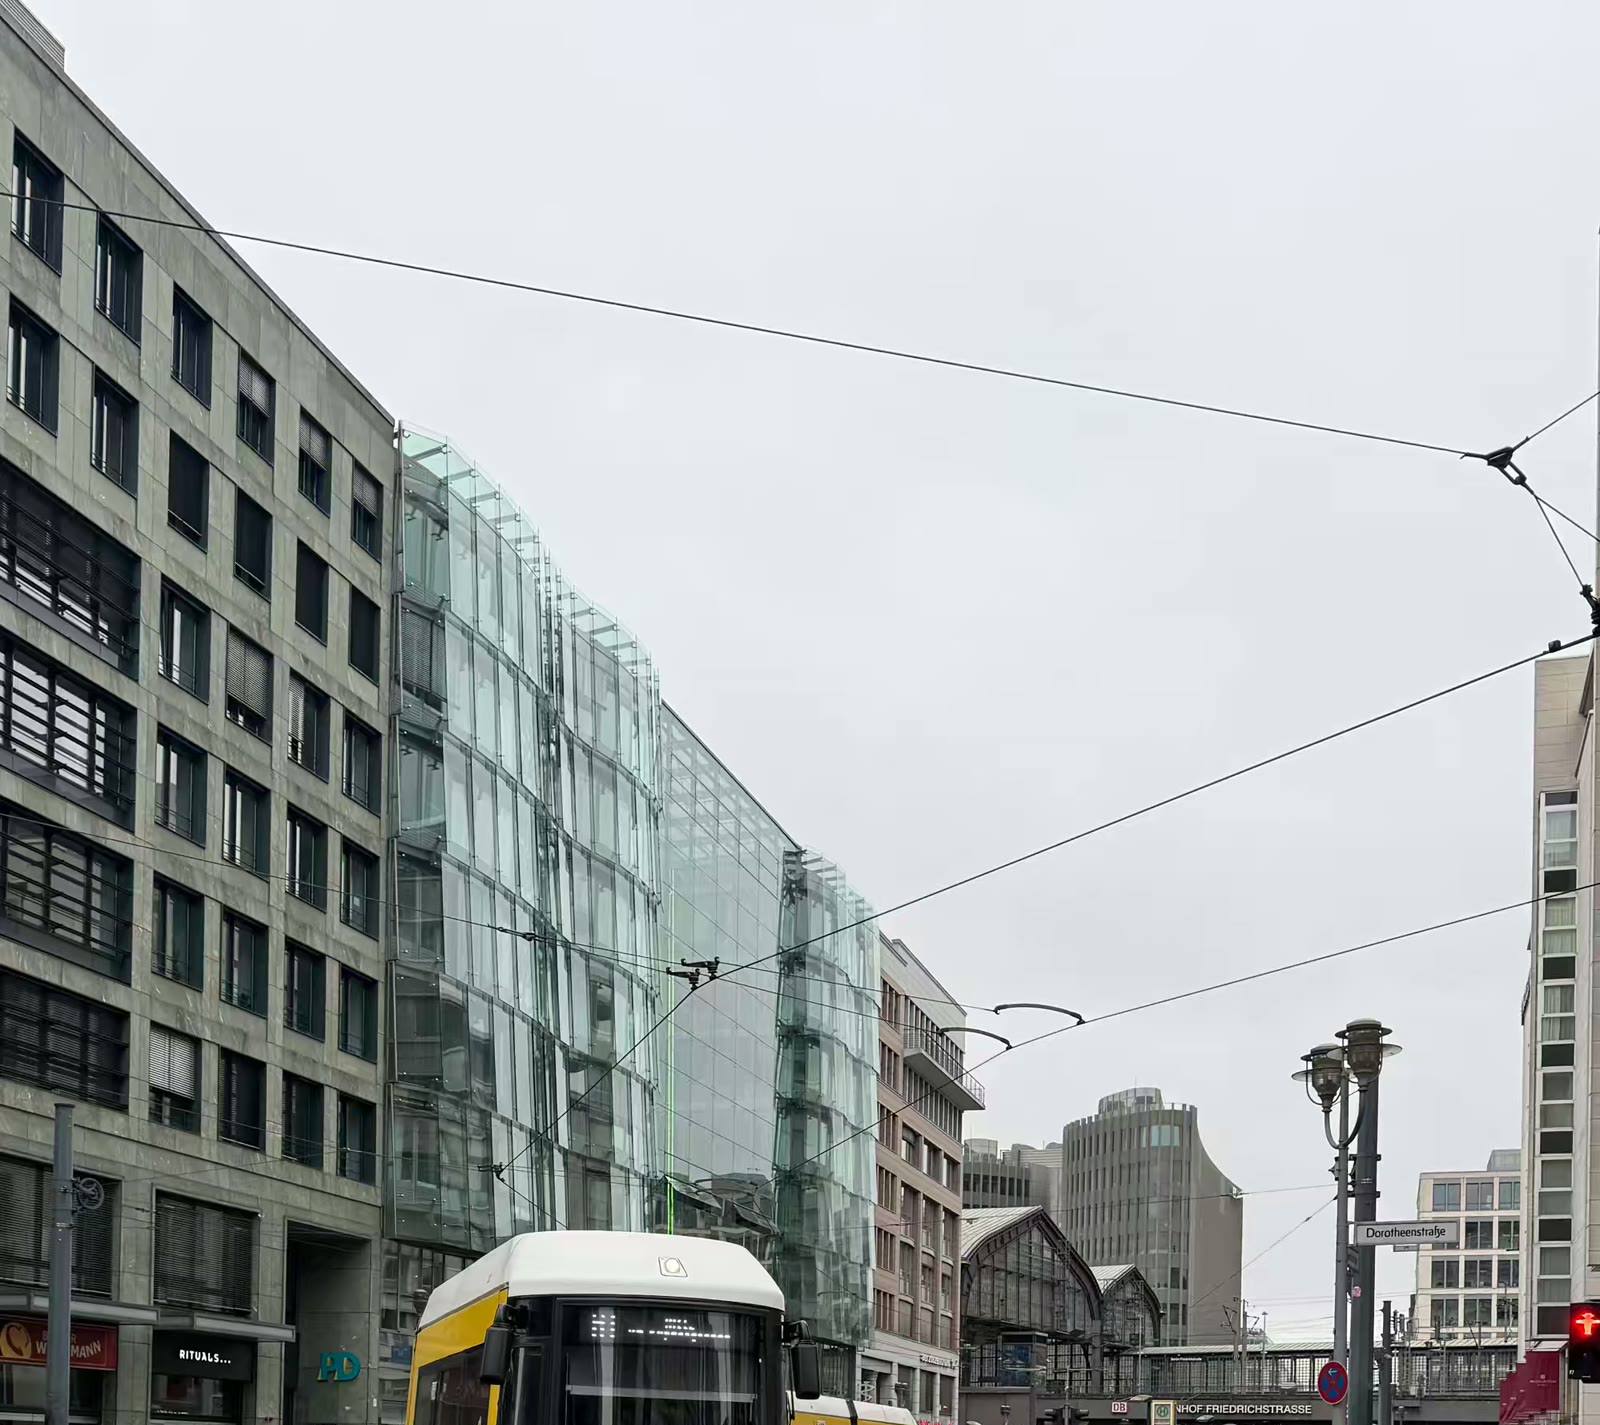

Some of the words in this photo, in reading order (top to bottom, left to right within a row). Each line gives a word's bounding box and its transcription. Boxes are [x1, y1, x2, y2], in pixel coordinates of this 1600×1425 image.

[1366, 1225, 1446, 1239] Dorotheenstraße
[317, 1352, 361, 1381] PD
[1113, 1402, 1127, 1412] DB
[1206, 1404, 1312, 1414] FRIEDRICHSTRASSE
